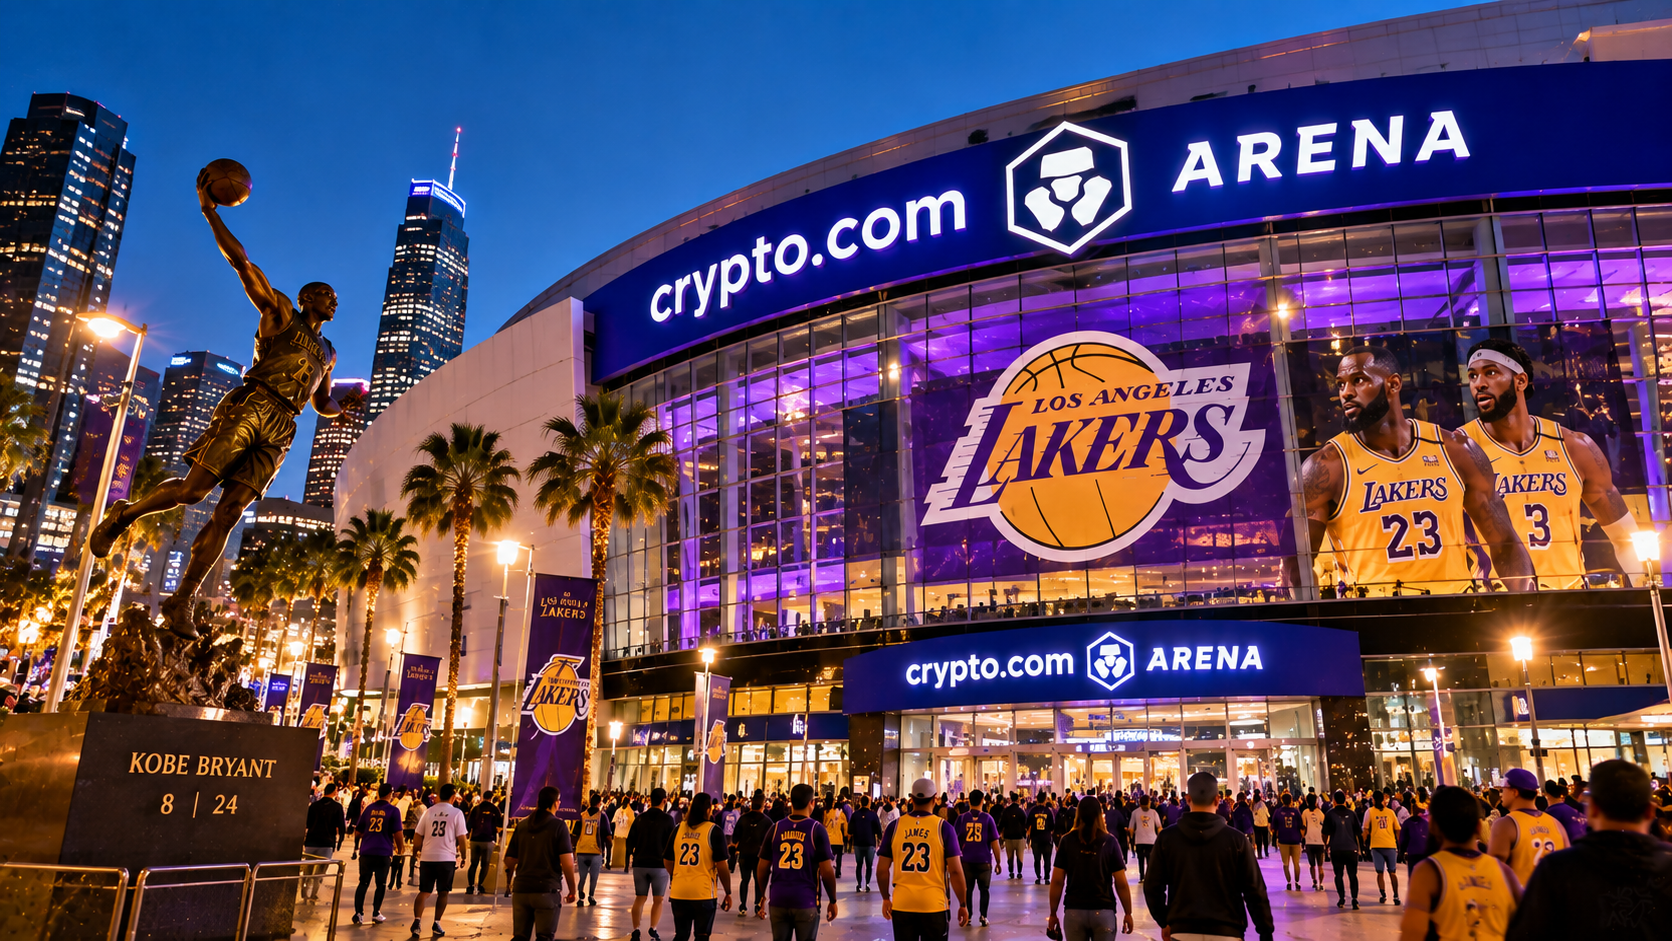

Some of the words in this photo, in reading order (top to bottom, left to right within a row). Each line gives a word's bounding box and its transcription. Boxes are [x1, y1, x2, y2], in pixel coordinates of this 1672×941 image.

[649, 189, 967, 325] crypto.com
[1171, 110, 1473, 193] ARENA
[1031, 393, 1083, 415] LOS
[1089, 375, 1235, 407] ANGELES
[939, 402, 1252, 512] LAKERS
[1359, 476, 1449, 513] LAKERS
[1381, 510, 1443, 563] 23
[1524, 503, 1552, 550] 3
[905, 652, 1074, 689] crypto.com
[1146, 645, 1264, 672] ARENA
[128, 751, 191, 776] KOBE
[195, 755, 277, 779] BRYANT
[160, 793, 175, 815] 8
[212, 794, 238, 815] 24
[368, 817, 384, 833] 23
[431, 820, 447, 837] 23
[904, 828, 930, 839] JAMES
[679, 843, 700, 866] 23
[778, 842, 804, 869] 23
[901, 842, 930, 872] 23
